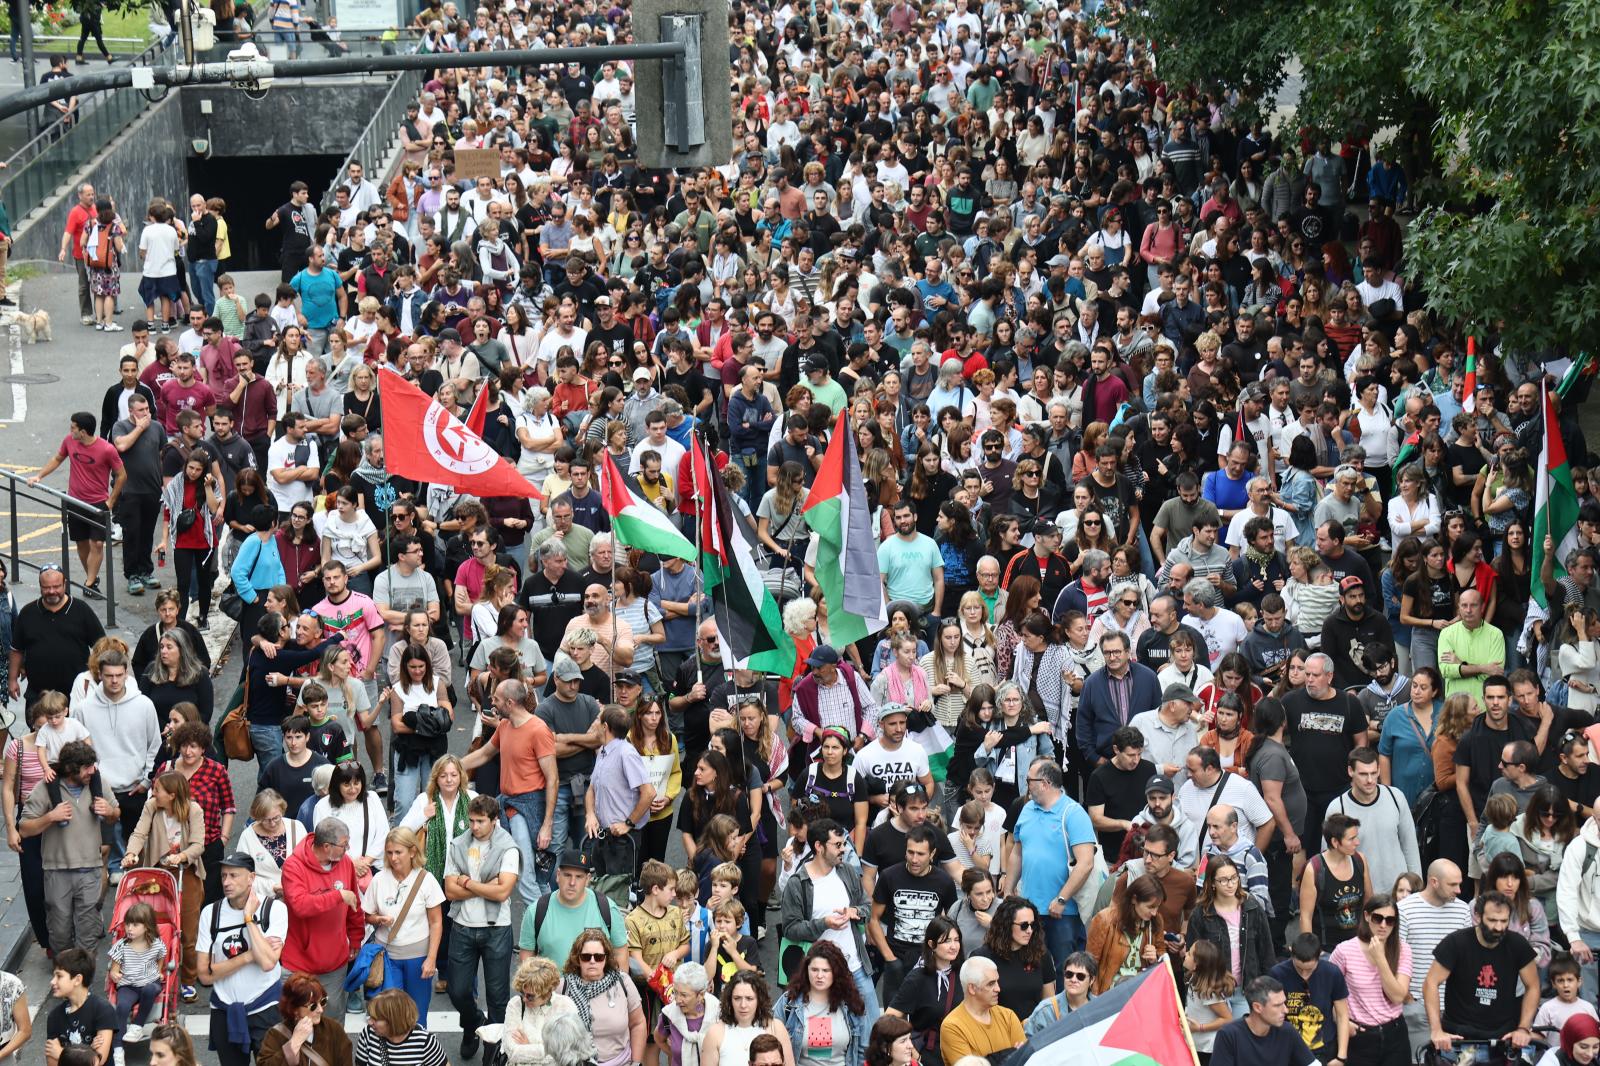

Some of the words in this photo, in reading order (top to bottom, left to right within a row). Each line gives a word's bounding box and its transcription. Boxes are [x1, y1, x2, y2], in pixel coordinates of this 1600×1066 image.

[1148, 649, 1167, 658] LINKIN
[872, 762, 913, 776] GAZA
[881, 774, 914, 786] SKATU
